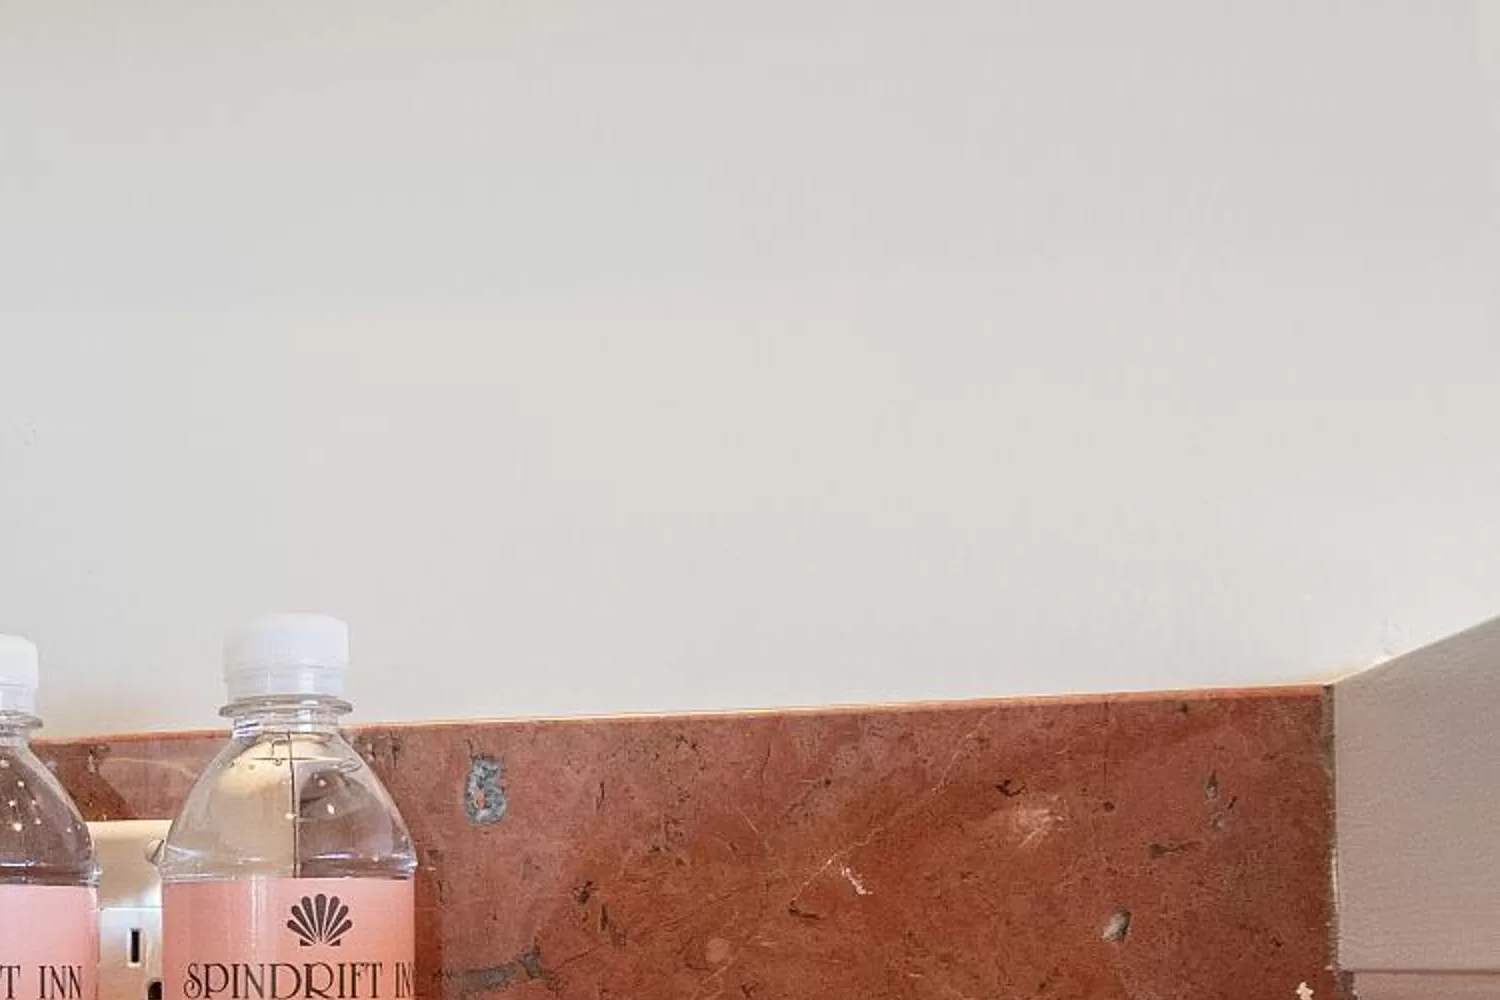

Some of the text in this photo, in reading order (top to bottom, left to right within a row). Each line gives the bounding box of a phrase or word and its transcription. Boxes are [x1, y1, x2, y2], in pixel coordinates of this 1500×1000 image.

[38, 964, 83, 1000] INN
[183, 961, 414, 1000] SPINDRIFT IN
